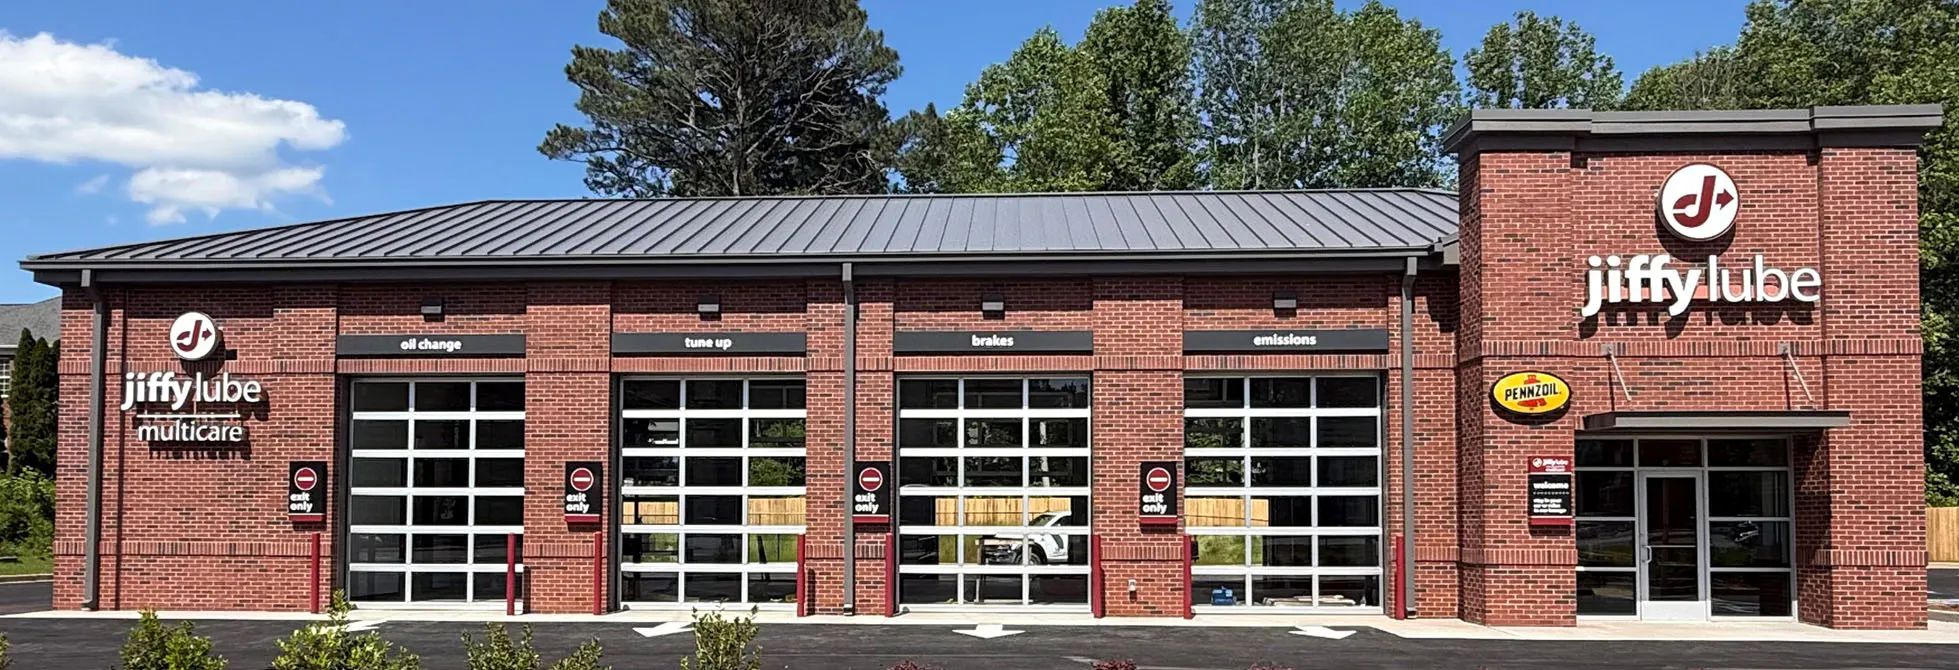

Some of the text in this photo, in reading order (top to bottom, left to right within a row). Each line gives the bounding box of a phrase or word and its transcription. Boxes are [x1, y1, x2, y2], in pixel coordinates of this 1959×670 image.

[1581, 253, 1822, 317] jiffy lube
[400, 337, 462, 353] oil change
[684, 337, 733, 351] tune up
[971, 334, 1014, 347] brakes
[1253, 333, 1317, 346] emissions
[120, 371, 262, 411] jiffy lube
[1504, 382, 1559, 402] PENNZOIL
[137, 420, 243, 443] multicare
[290, 491, 310, 502] exit
[566, 492, 587, 502] exit
[855, 492, 876, 503] exit
[1142, 492, 1164, 503] exit
[290, 501, 313, 513] only
[566, 502, 590, 514] only
[855, 502, 880, 514] only
[1142, 502, 1168, 515] only
